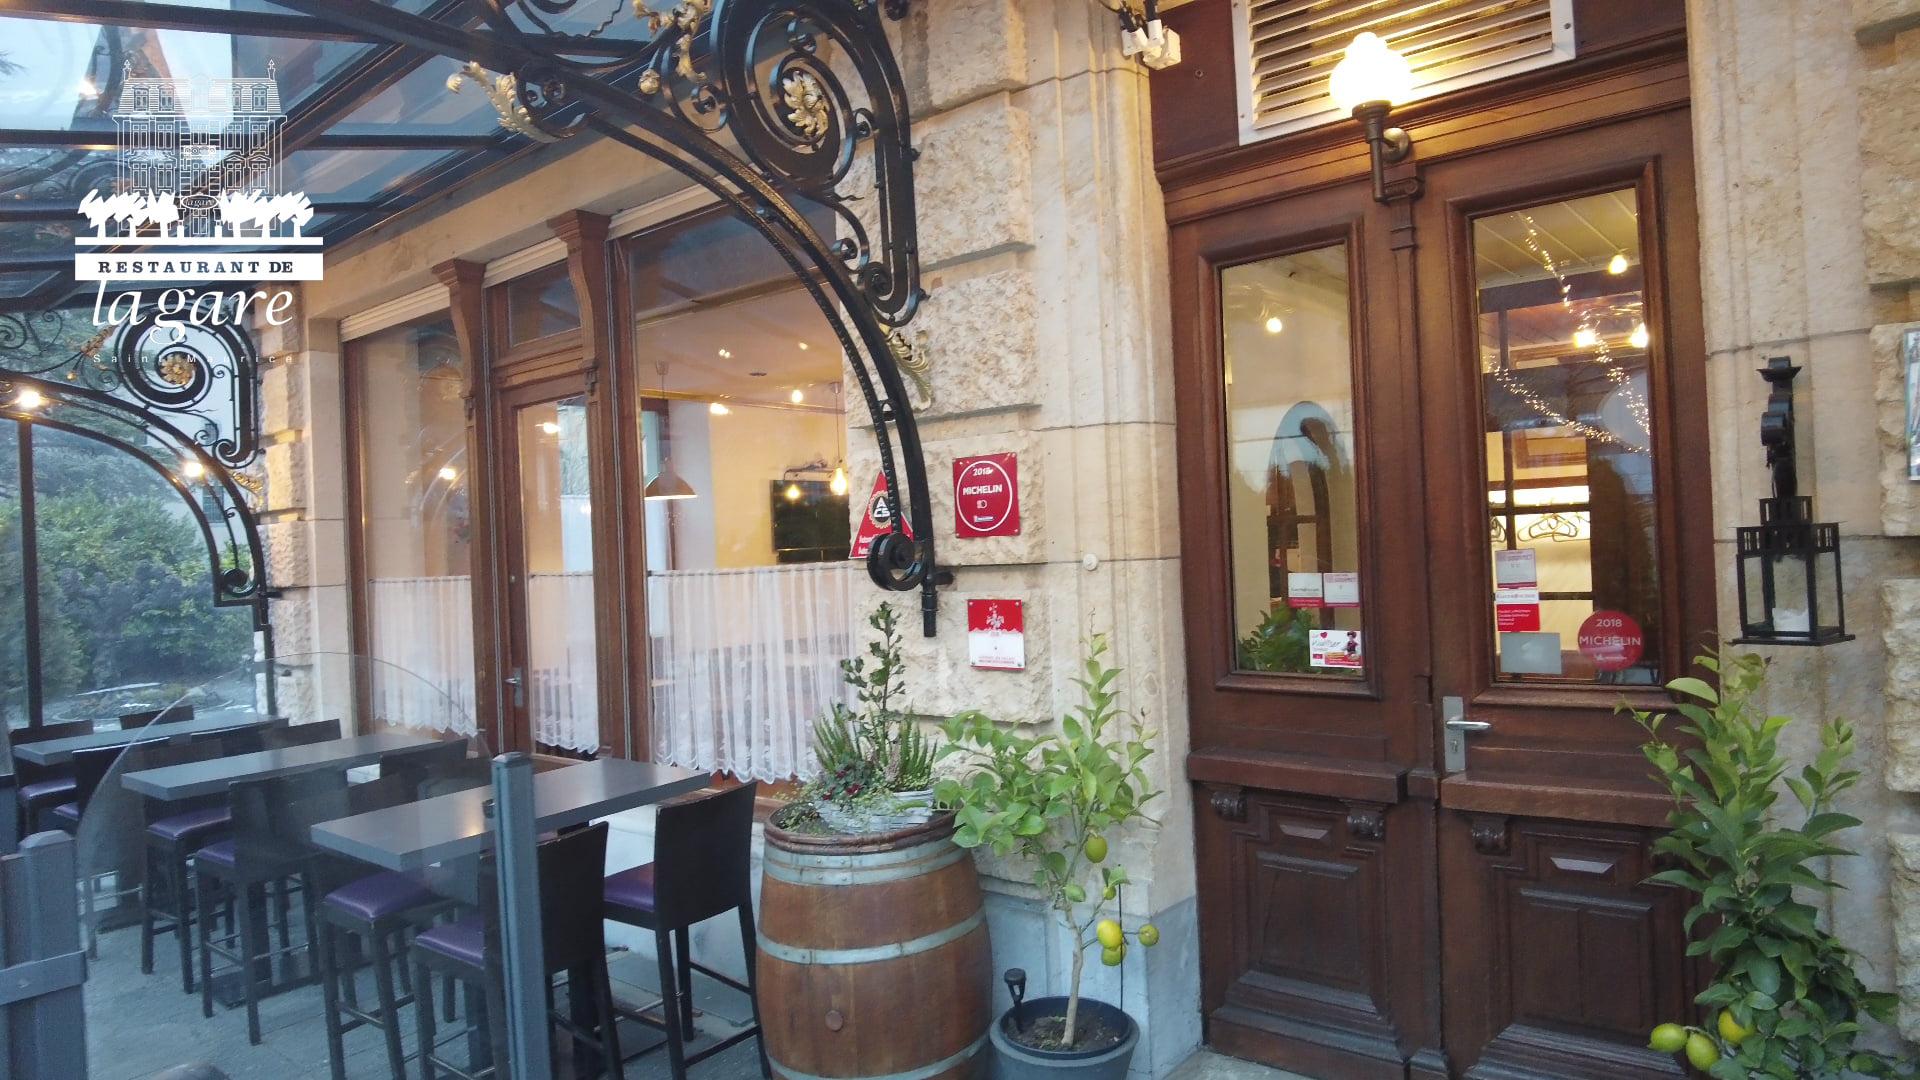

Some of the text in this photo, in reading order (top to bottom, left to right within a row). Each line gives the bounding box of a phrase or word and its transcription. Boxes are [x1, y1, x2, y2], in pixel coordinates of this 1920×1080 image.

[963, 484, 1002, 495] MICHELIN
[1596, 618, 1622, 627] 2018
[1579, 636, 1641, 646] MICHELIN
